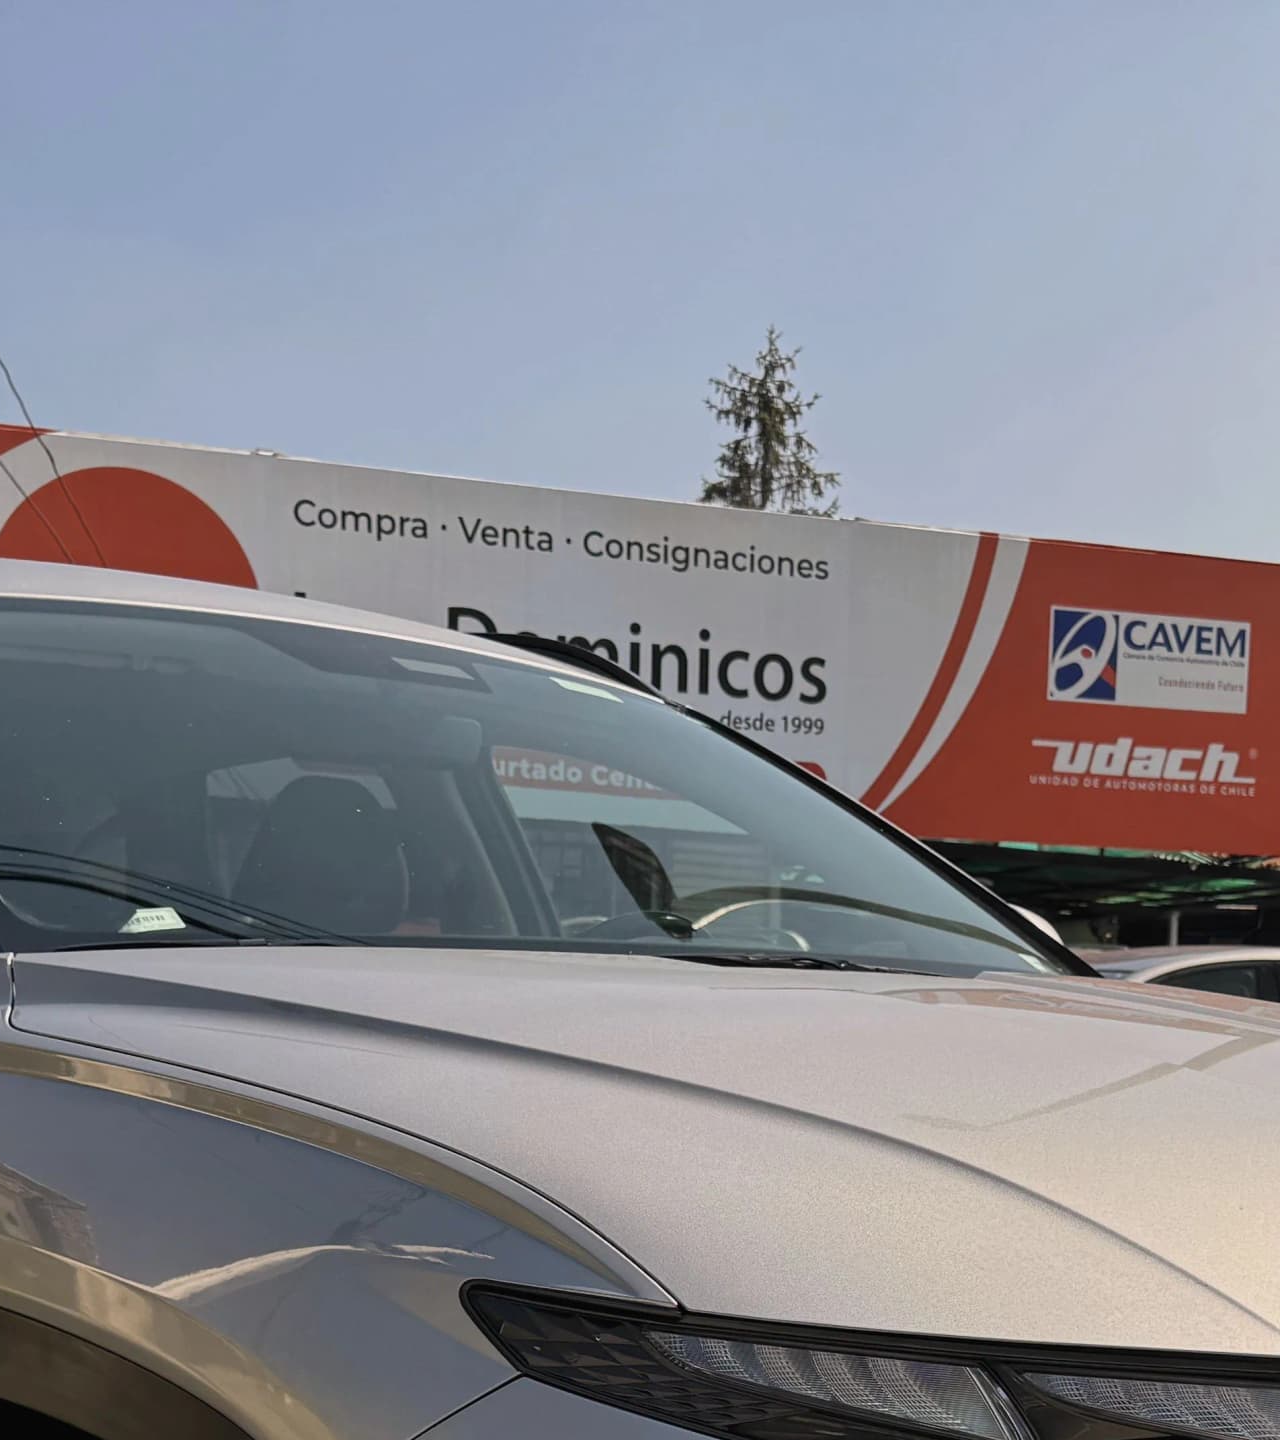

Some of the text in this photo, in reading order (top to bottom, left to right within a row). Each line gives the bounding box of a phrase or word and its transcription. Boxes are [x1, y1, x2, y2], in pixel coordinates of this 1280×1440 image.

[293, 499, 830, 580] Compra Venta Consignaciones
[448, 606, 827, 704] inicos
[1123, 620, 1246, 658] CAVEM
[720, 709, 825, 735] desde 1999
[1031, 737, 1257, 785] udach
[1028, 774, 1257, 798] UNIDAD DE AUTOMOTORAS DE CHILE
